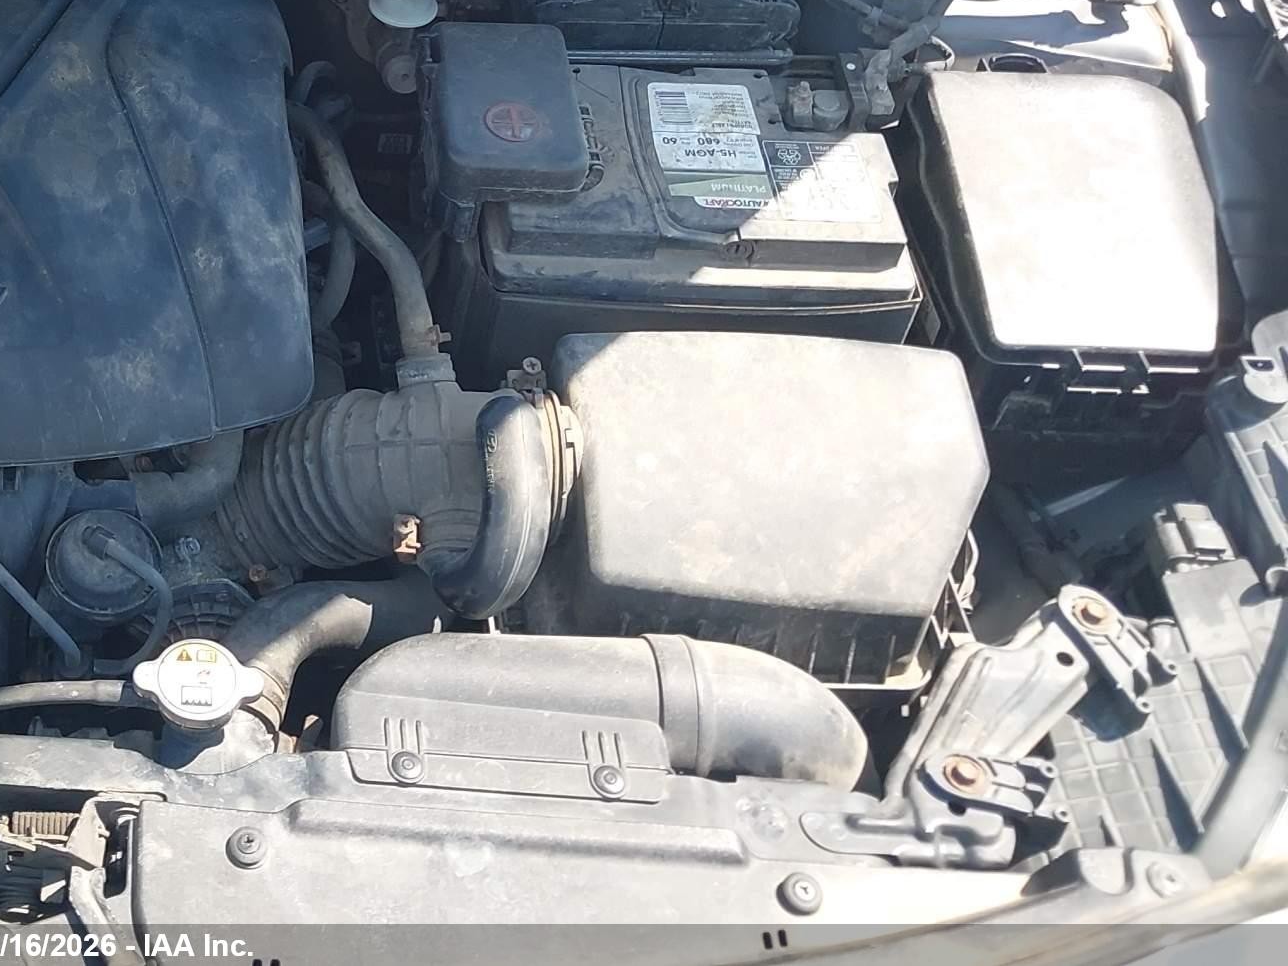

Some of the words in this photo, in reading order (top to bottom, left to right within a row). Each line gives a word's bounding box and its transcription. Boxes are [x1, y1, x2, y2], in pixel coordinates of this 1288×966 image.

[662, 137, 677, 146] 60
[697, 137, 720, 146] 680
[684, 149, 736, 158] H5-AGM
[711, 183, 766, 193] PLATINUM
[705, 199, 763, 207] AUTOCRAFT
